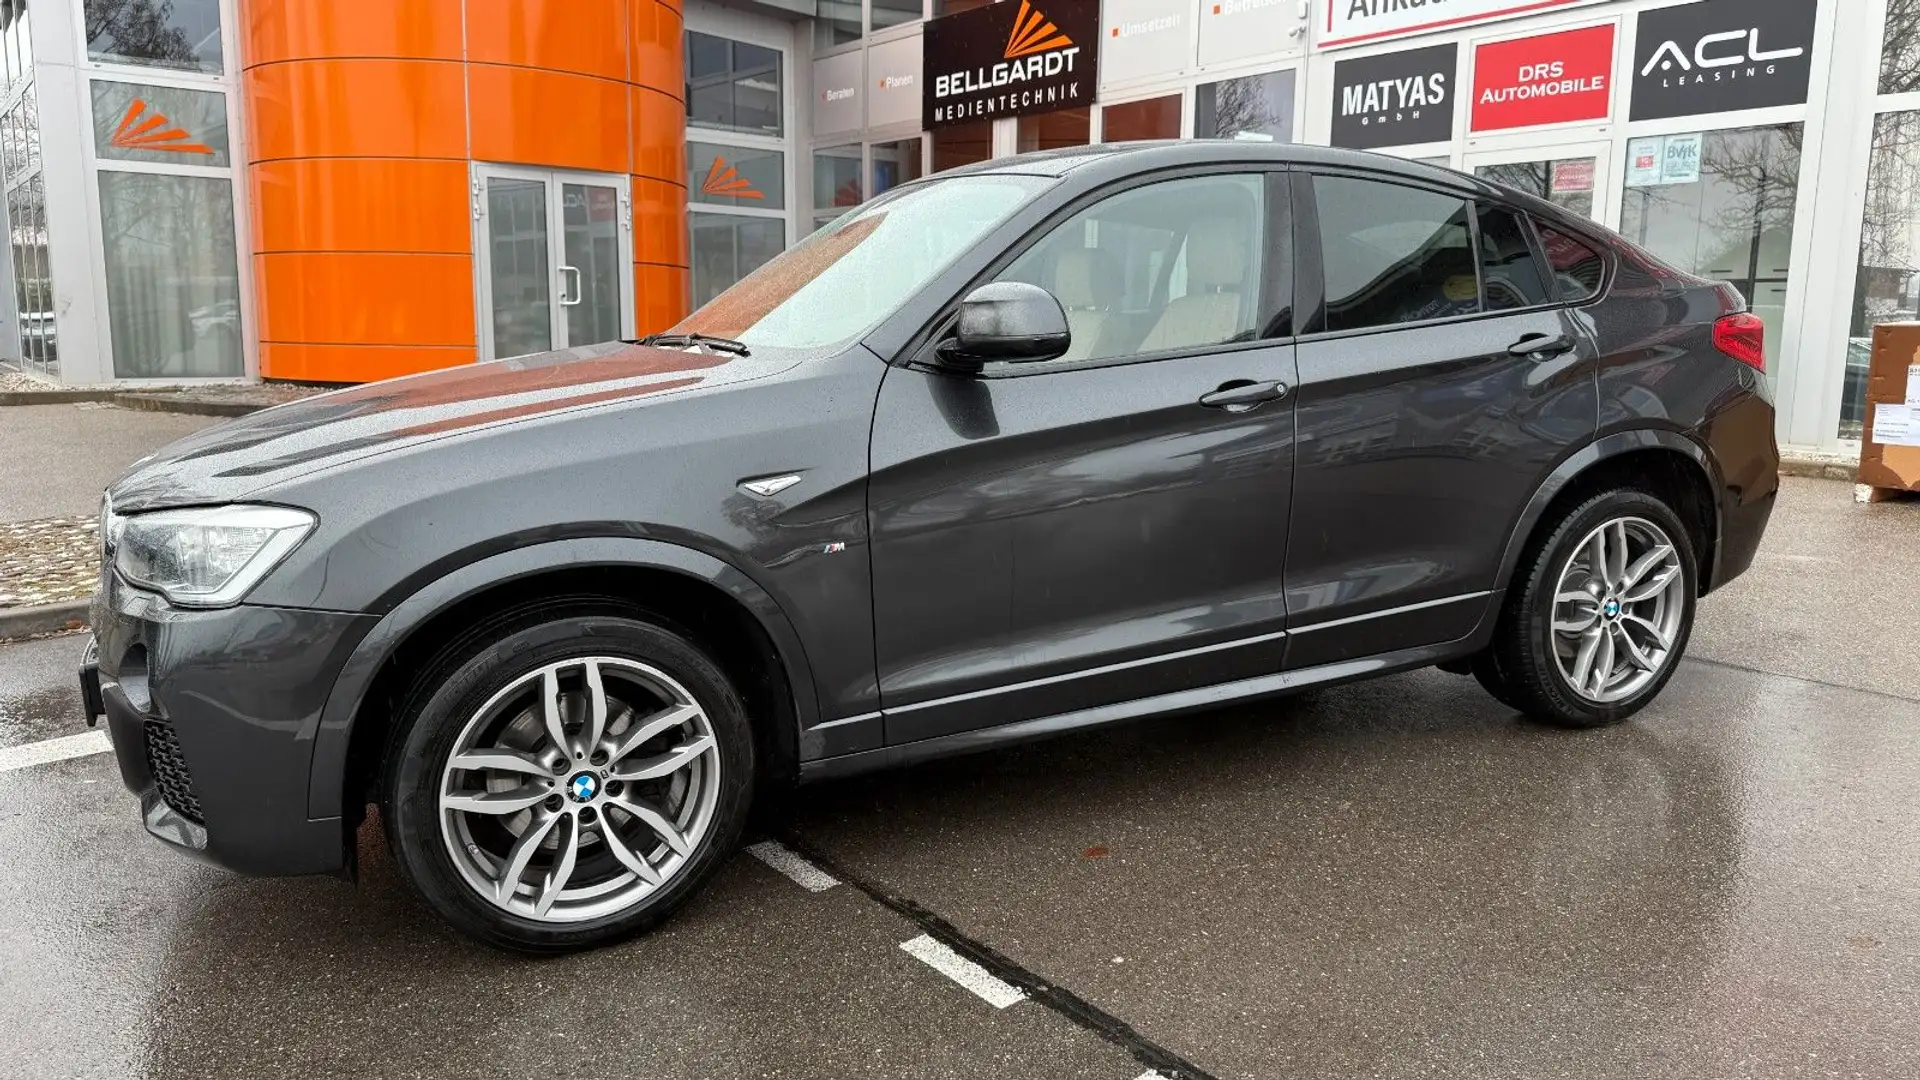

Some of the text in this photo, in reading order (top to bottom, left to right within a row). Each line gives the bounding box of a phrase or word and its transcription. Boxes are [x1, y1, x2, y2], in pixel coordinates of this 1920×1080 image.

[935, 47, 1080, 98] BELLGARDT
[1518, 61, 1564, 82] DRS
[1641, 28, 1804, 77] ACL
[1341, 73, 1446, 117] MATYAS
[1480, 76, 1604, 104] AUTOMOBILE
[1663, 65, 1776, 88] LEASING
[935, 82, 1079, 122] MEDIENTECHNIK
